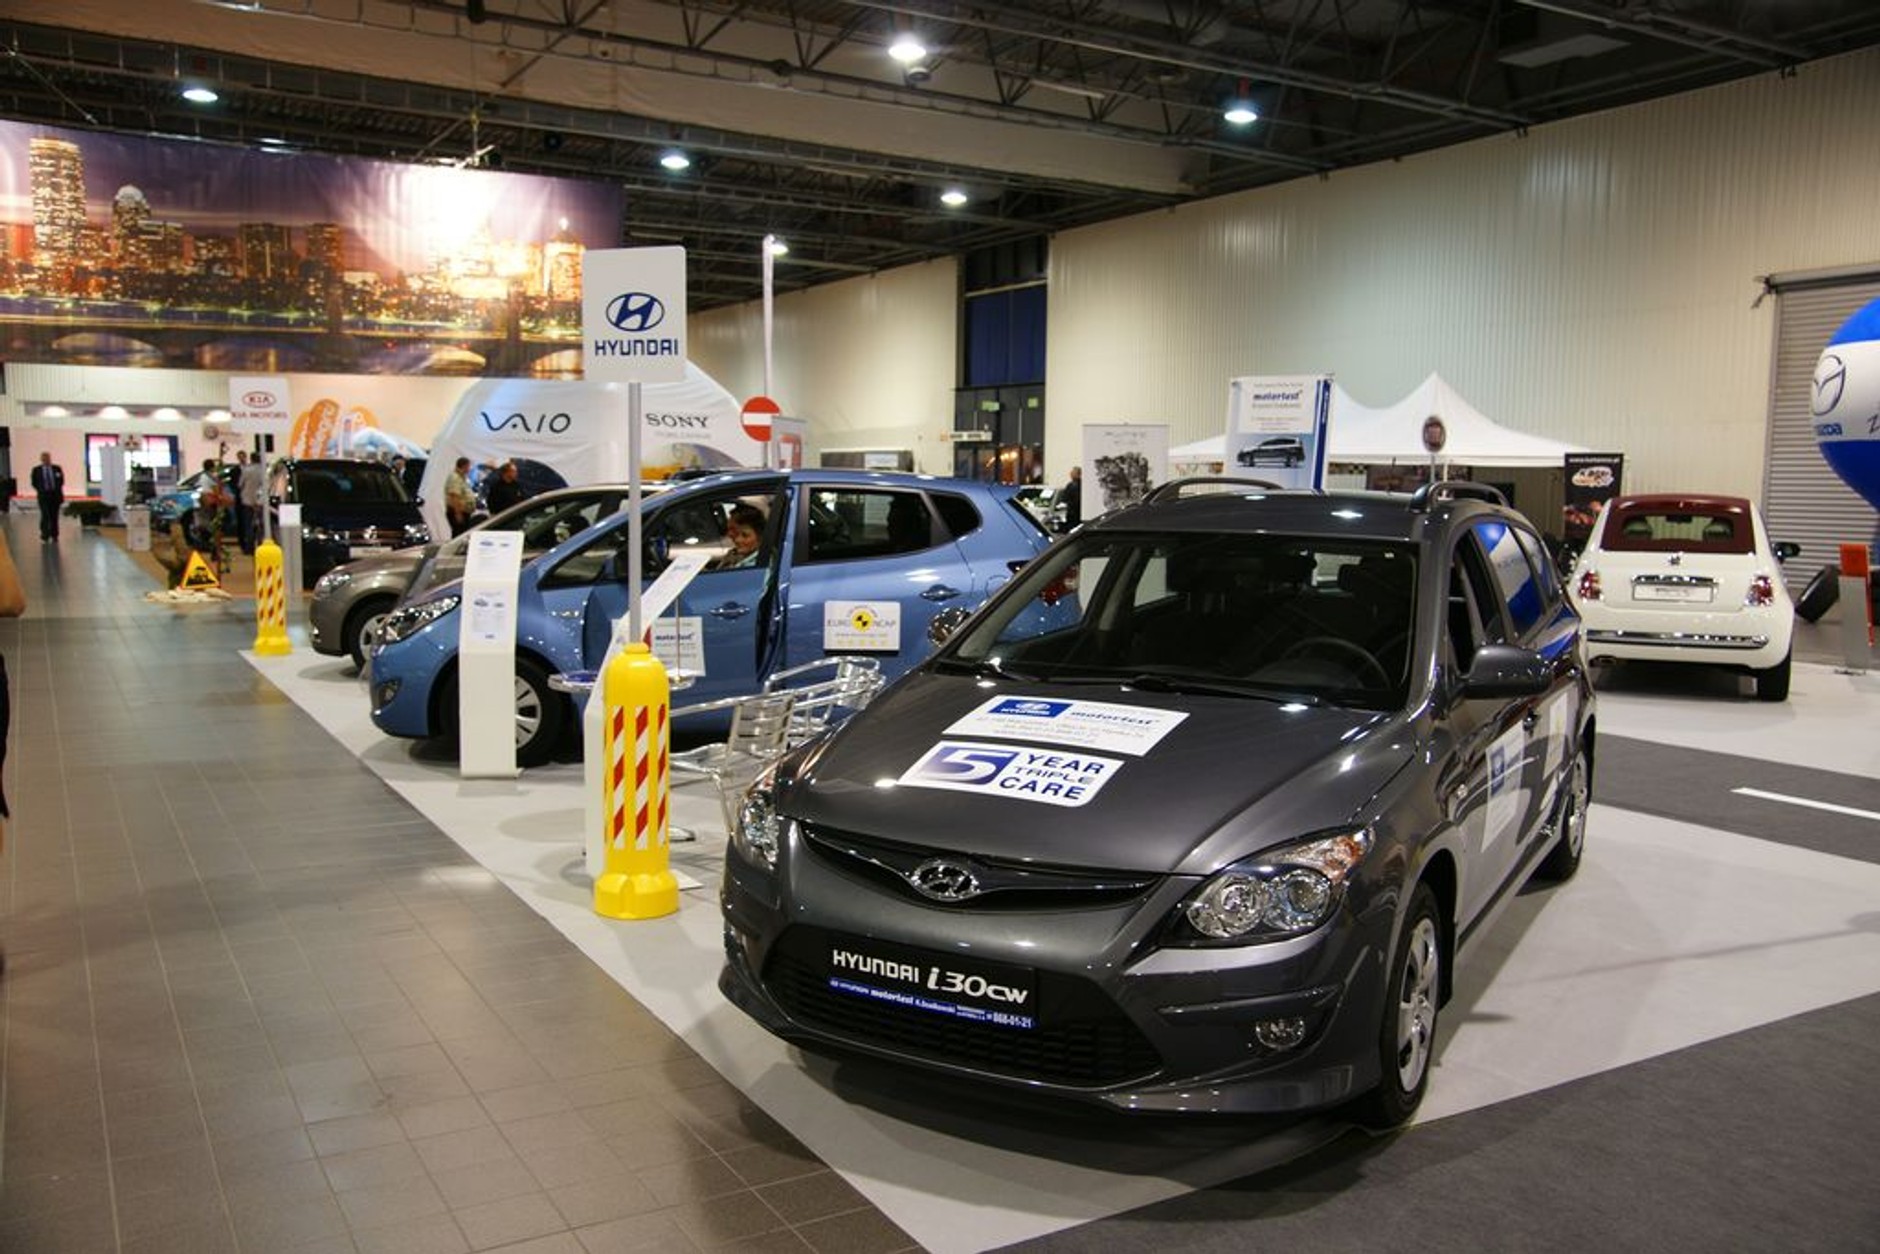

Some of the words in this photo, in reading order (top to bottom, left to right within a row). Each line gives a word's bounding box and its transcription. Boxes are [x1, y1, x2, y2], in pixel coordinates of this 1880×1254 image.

[594, 338, 679, 356] HYUNDAI
[480, 411, 572, 435] VAIO
[645, 412, 710, 429] SONY
[925, 748, 1014, 781] 5
[1025, 752, 1105, 775] YEAR
[1013, 766, 1095, 785] TRIPLE
[998, 776, 1087, 801] CARE
[832, 949, 920, 984] HYUNDAI
